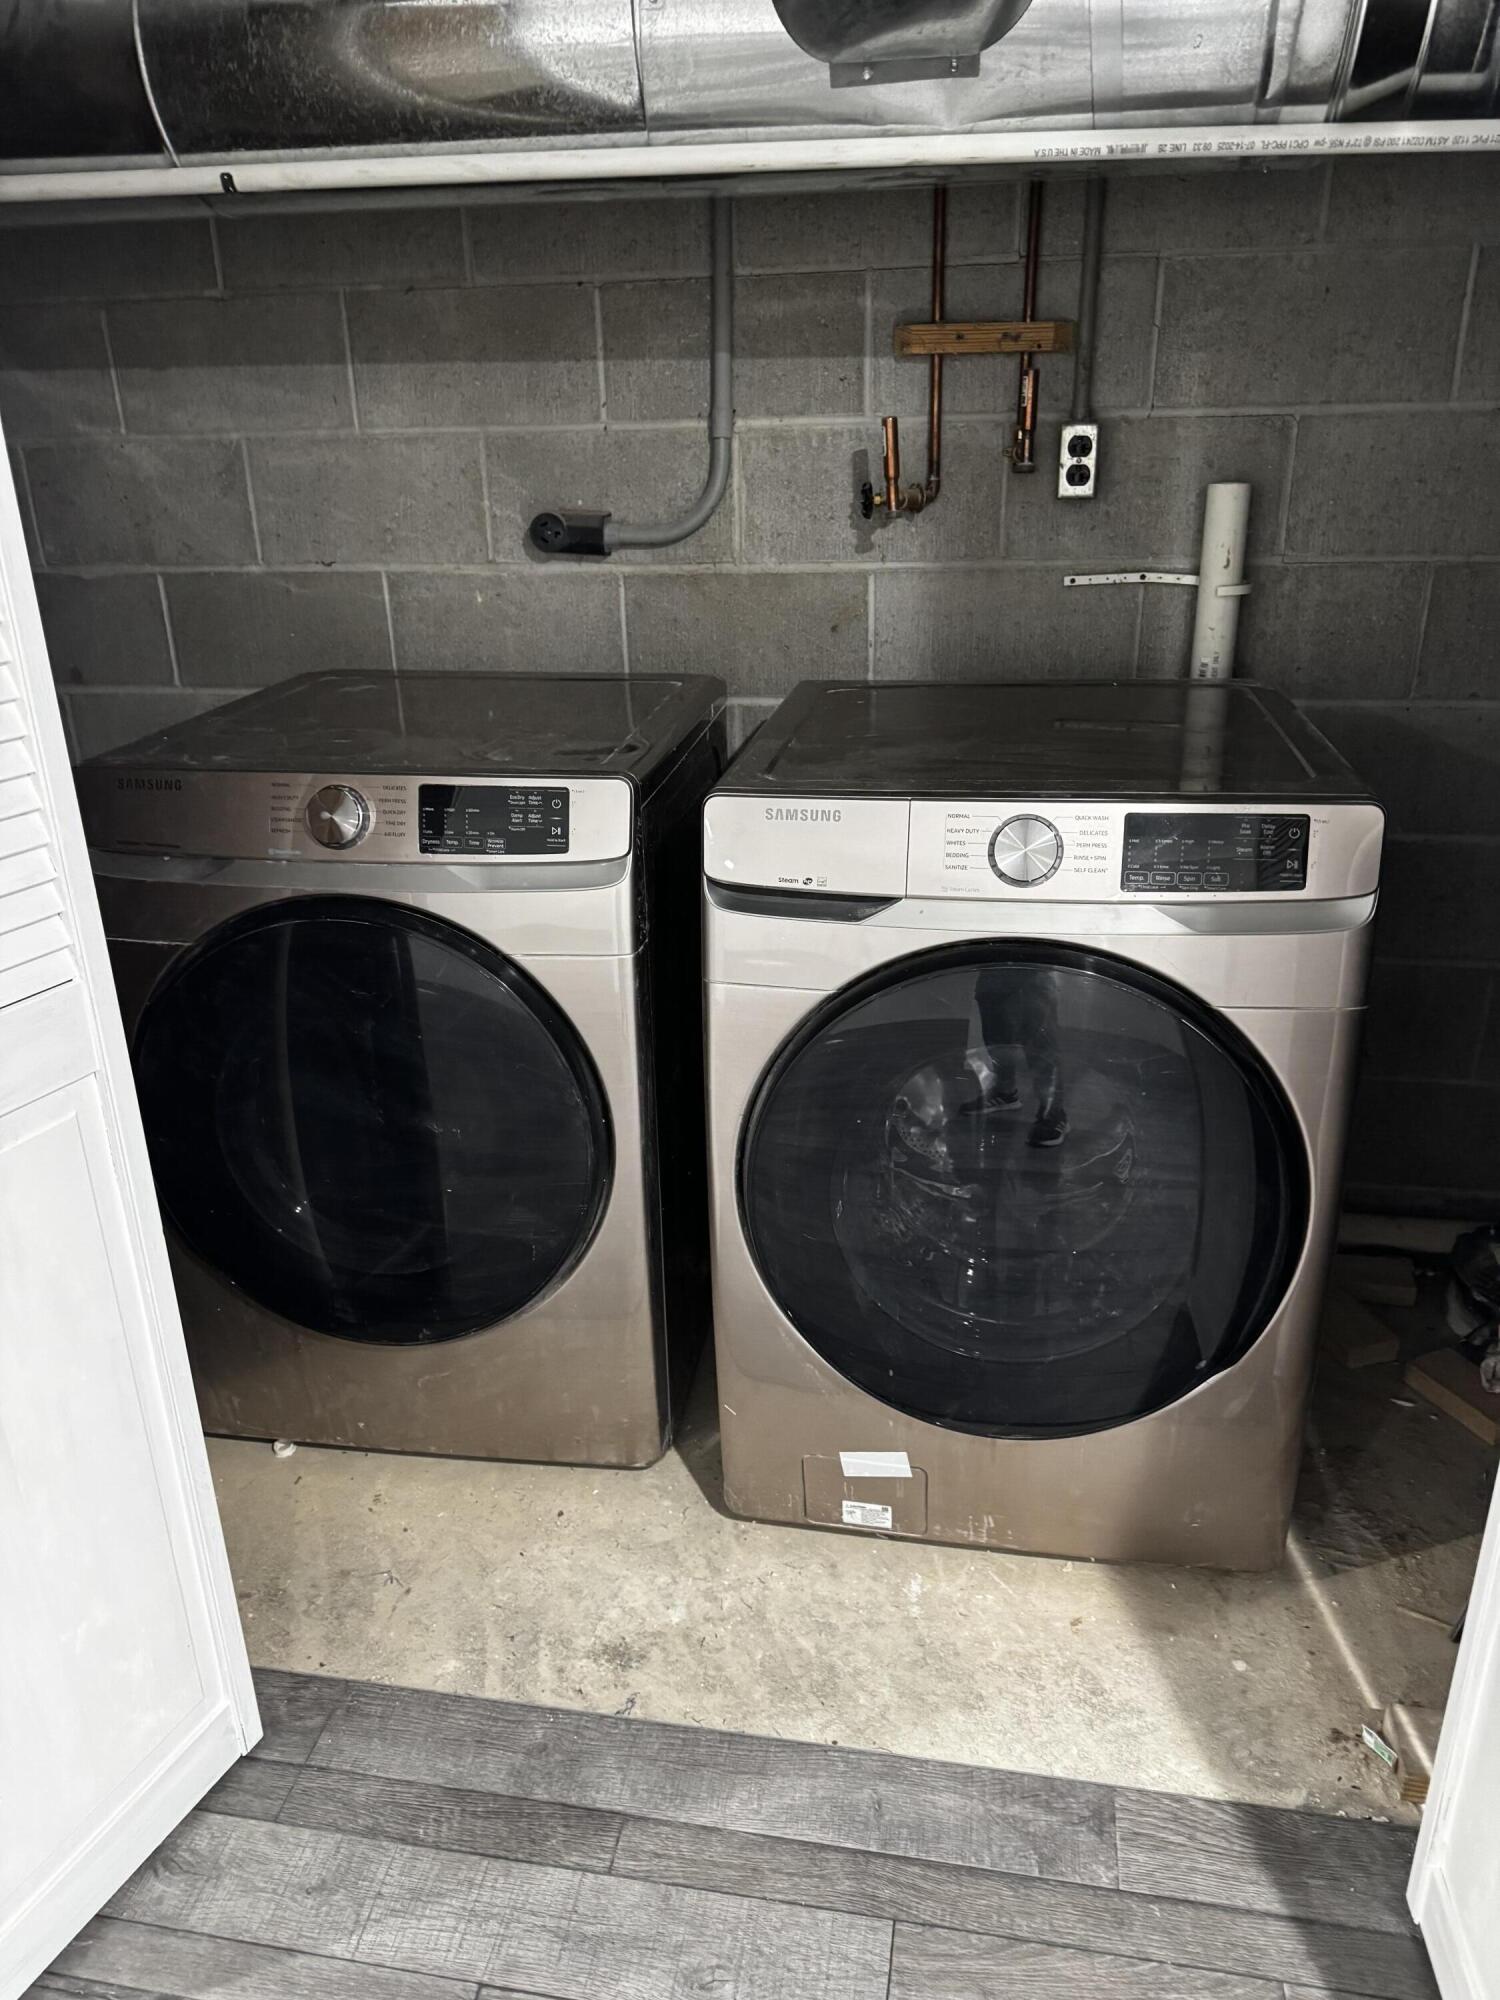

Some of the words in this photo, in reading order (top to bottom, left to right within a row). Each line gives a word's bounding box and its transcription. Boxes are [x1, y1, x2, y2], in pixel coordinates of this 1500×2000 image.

[1426, 136, 1450, 146] ASTM
[1473, 134, 1490, 144] PVC
[1054, 148, 1068, 156] THE
[1070, 148, 1078, 156] IN
[1078, 147, 1101, 156] MADE
[1169, 143, 1187, 153] LINE
[116, 776, 184, 792] SAMSUNG
[764, 807, 842, 823] SAMSUNG
[778, 876, 799, 884] Steam
[1129, 874, 1145, 882] Temp.
[1183, 876, 1196, 884] Spin
